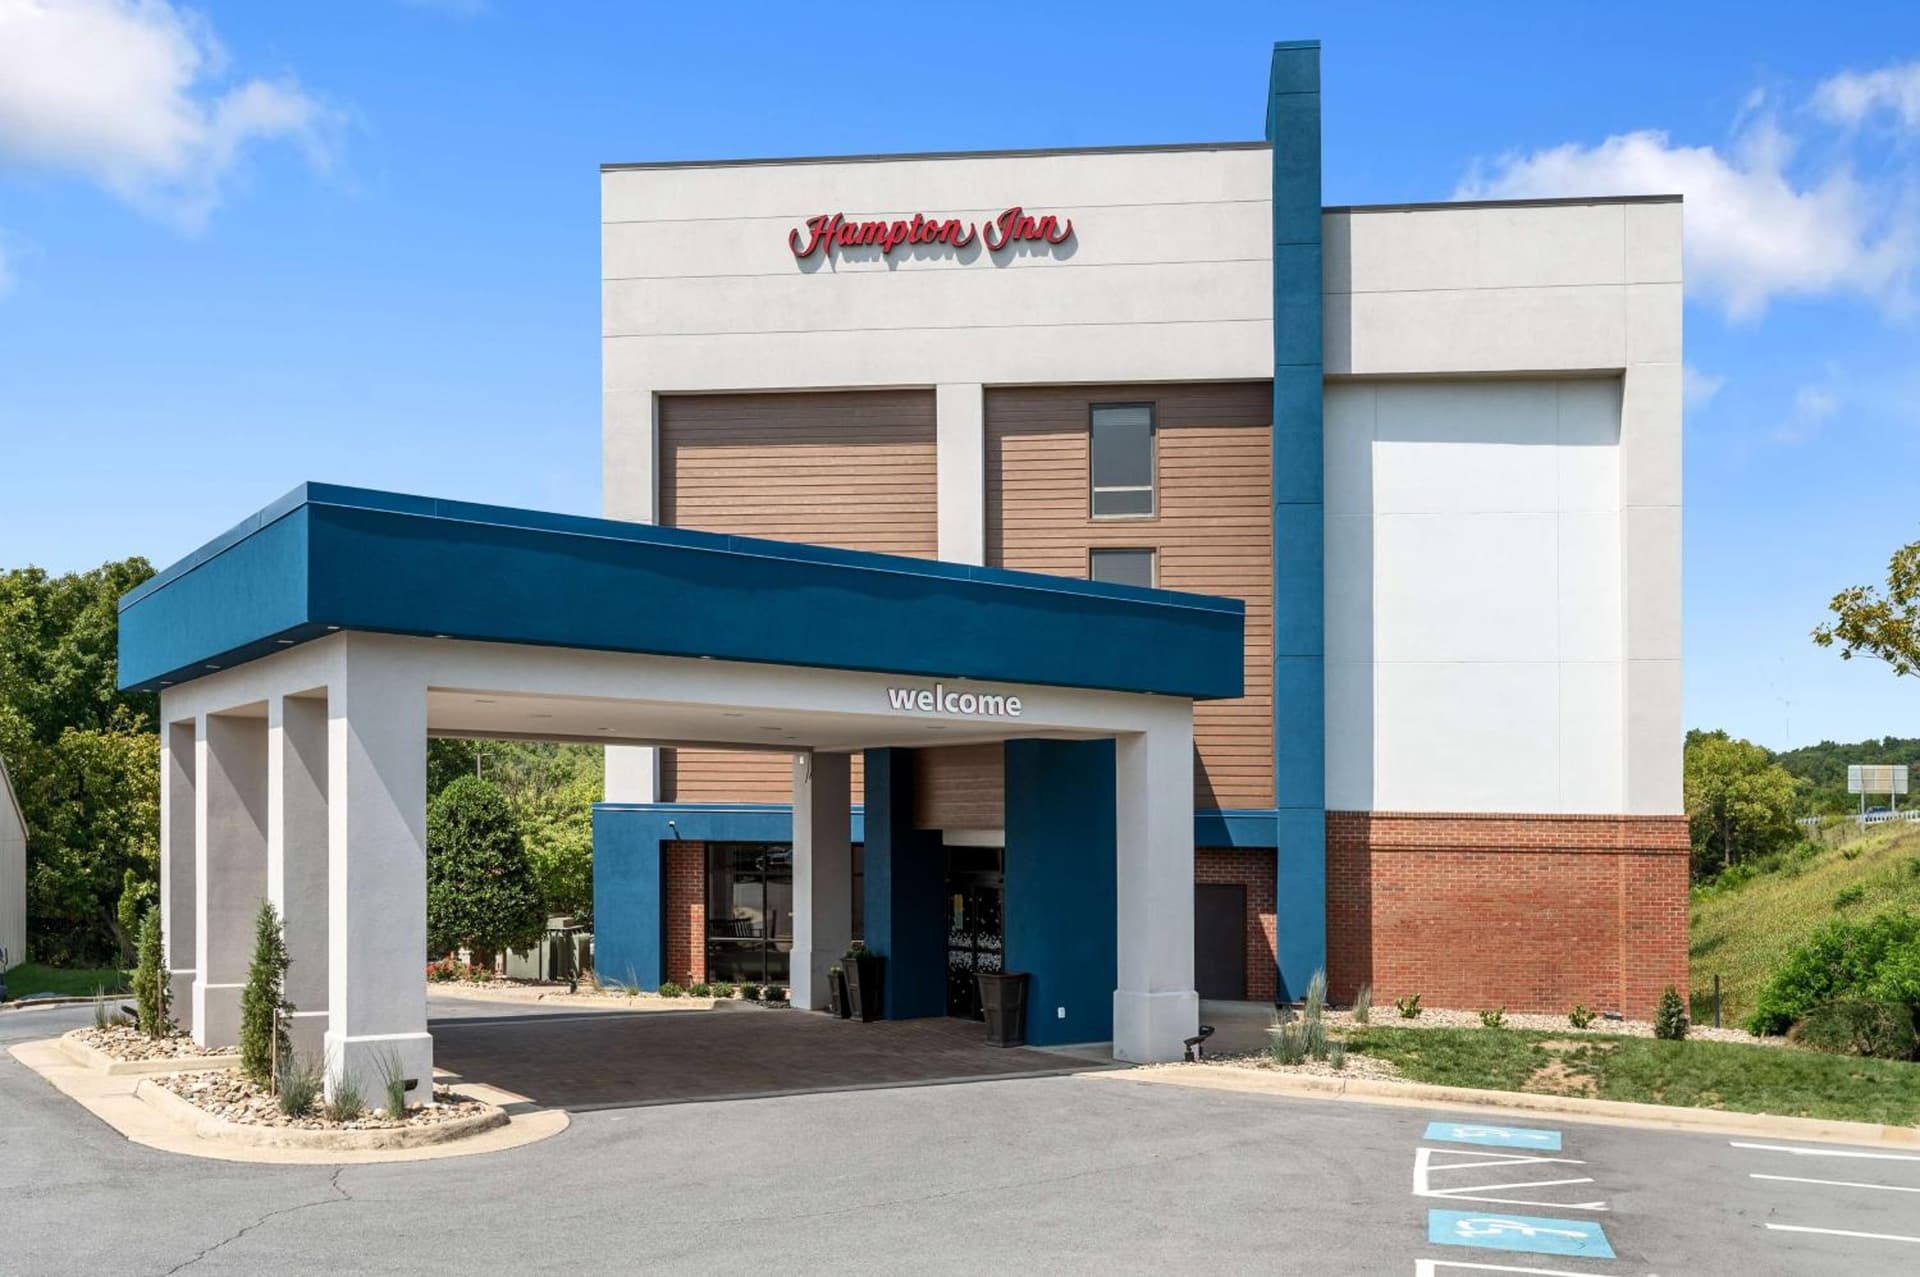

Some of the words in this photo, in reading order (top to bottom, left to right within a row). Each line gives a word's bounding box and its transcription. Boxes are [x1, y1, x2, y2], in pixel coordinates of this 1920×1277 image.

[788, 212, 976, 258] Hampton
[983, 207, 1072, 251] Inn
[888, 683, 1022, 717] welcome
